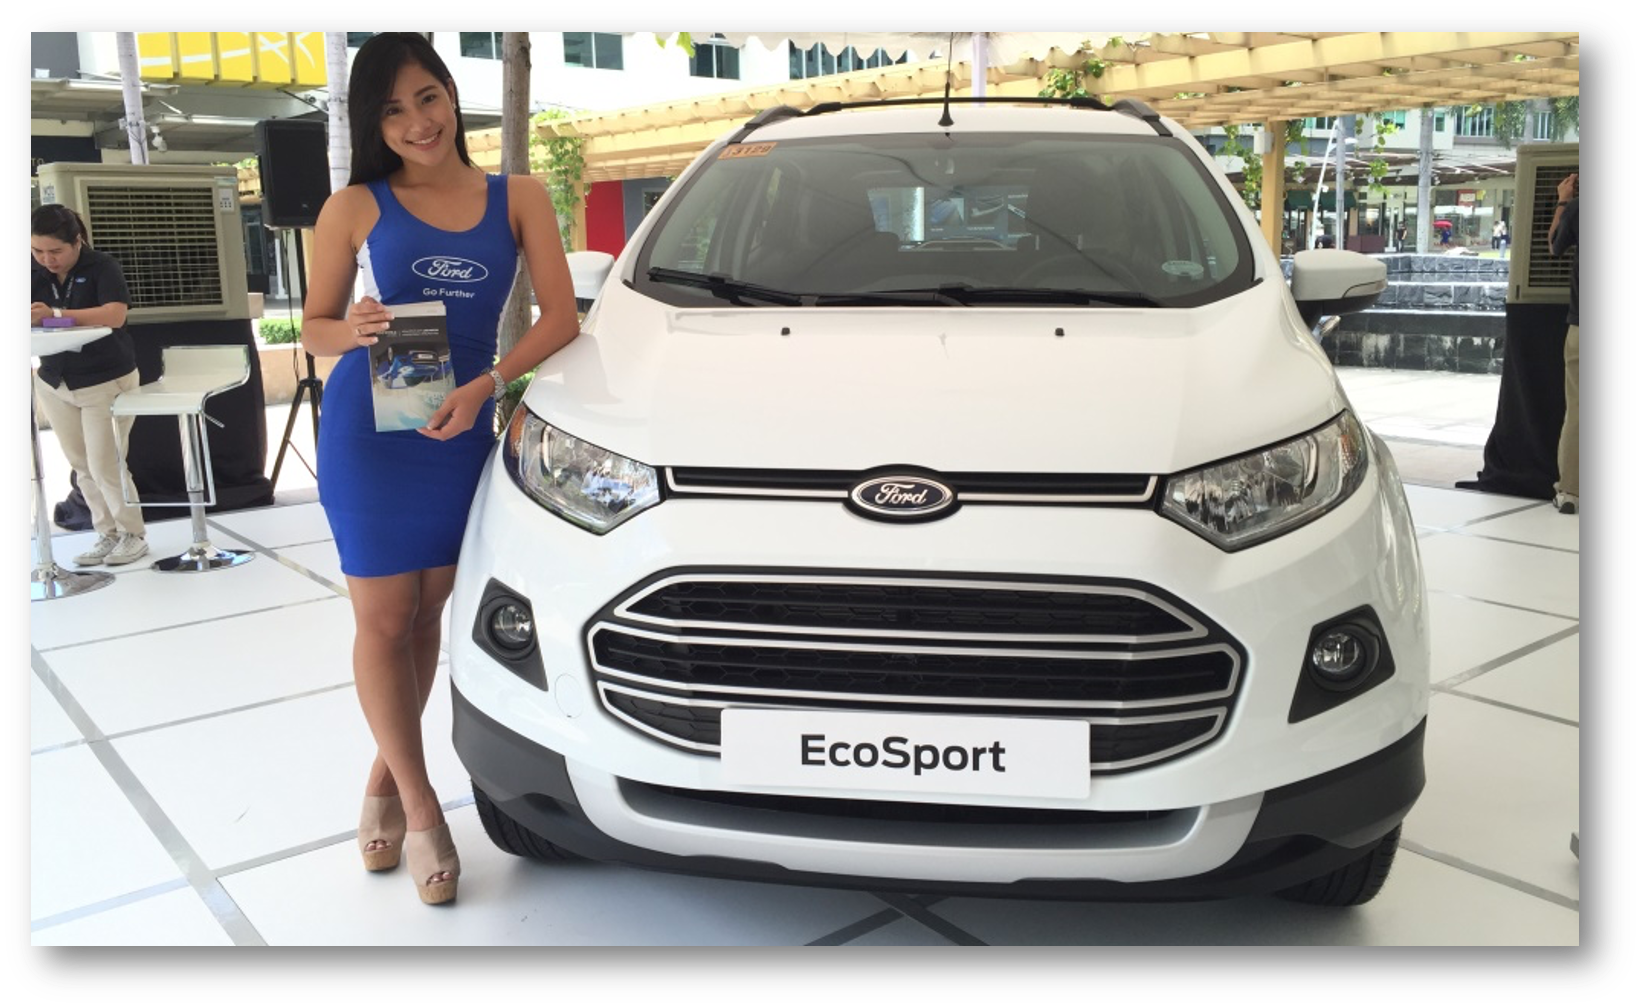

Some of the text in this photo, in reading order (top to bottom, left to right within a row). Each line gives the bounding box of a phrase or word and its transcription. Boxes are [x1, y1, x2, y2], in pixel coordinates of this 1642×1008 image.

[427, 259, 474, 279] Ford
[422, 287, 475, 299] Go Further
[874, 483, 929, 505] Ford
[800, 734, 1006, 776] EcoSport
